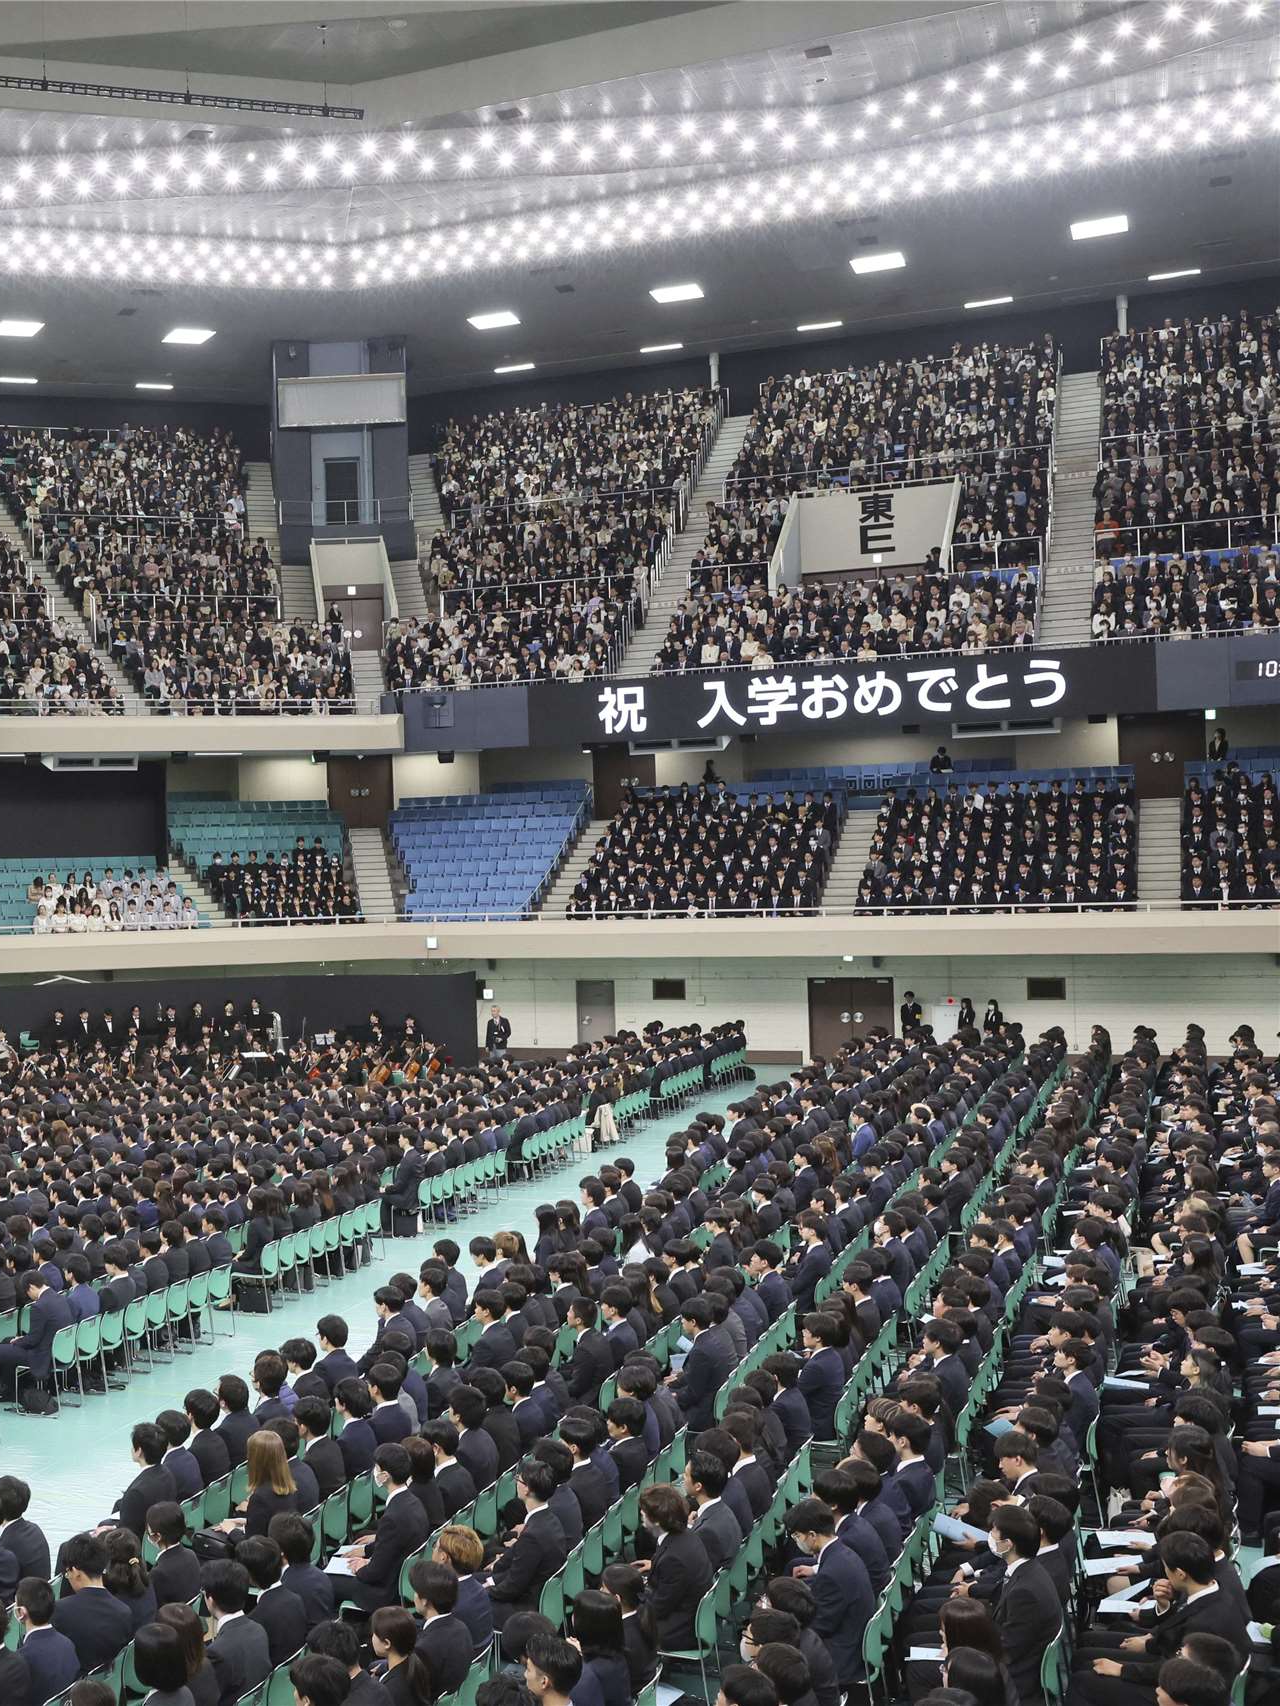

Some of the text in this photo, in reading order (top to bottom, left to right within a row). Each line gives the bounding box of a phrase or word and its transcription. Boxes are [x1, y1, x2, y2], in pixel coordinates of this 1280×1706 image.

[597, 659, 1066, 735] 祝 入学おめでとう
